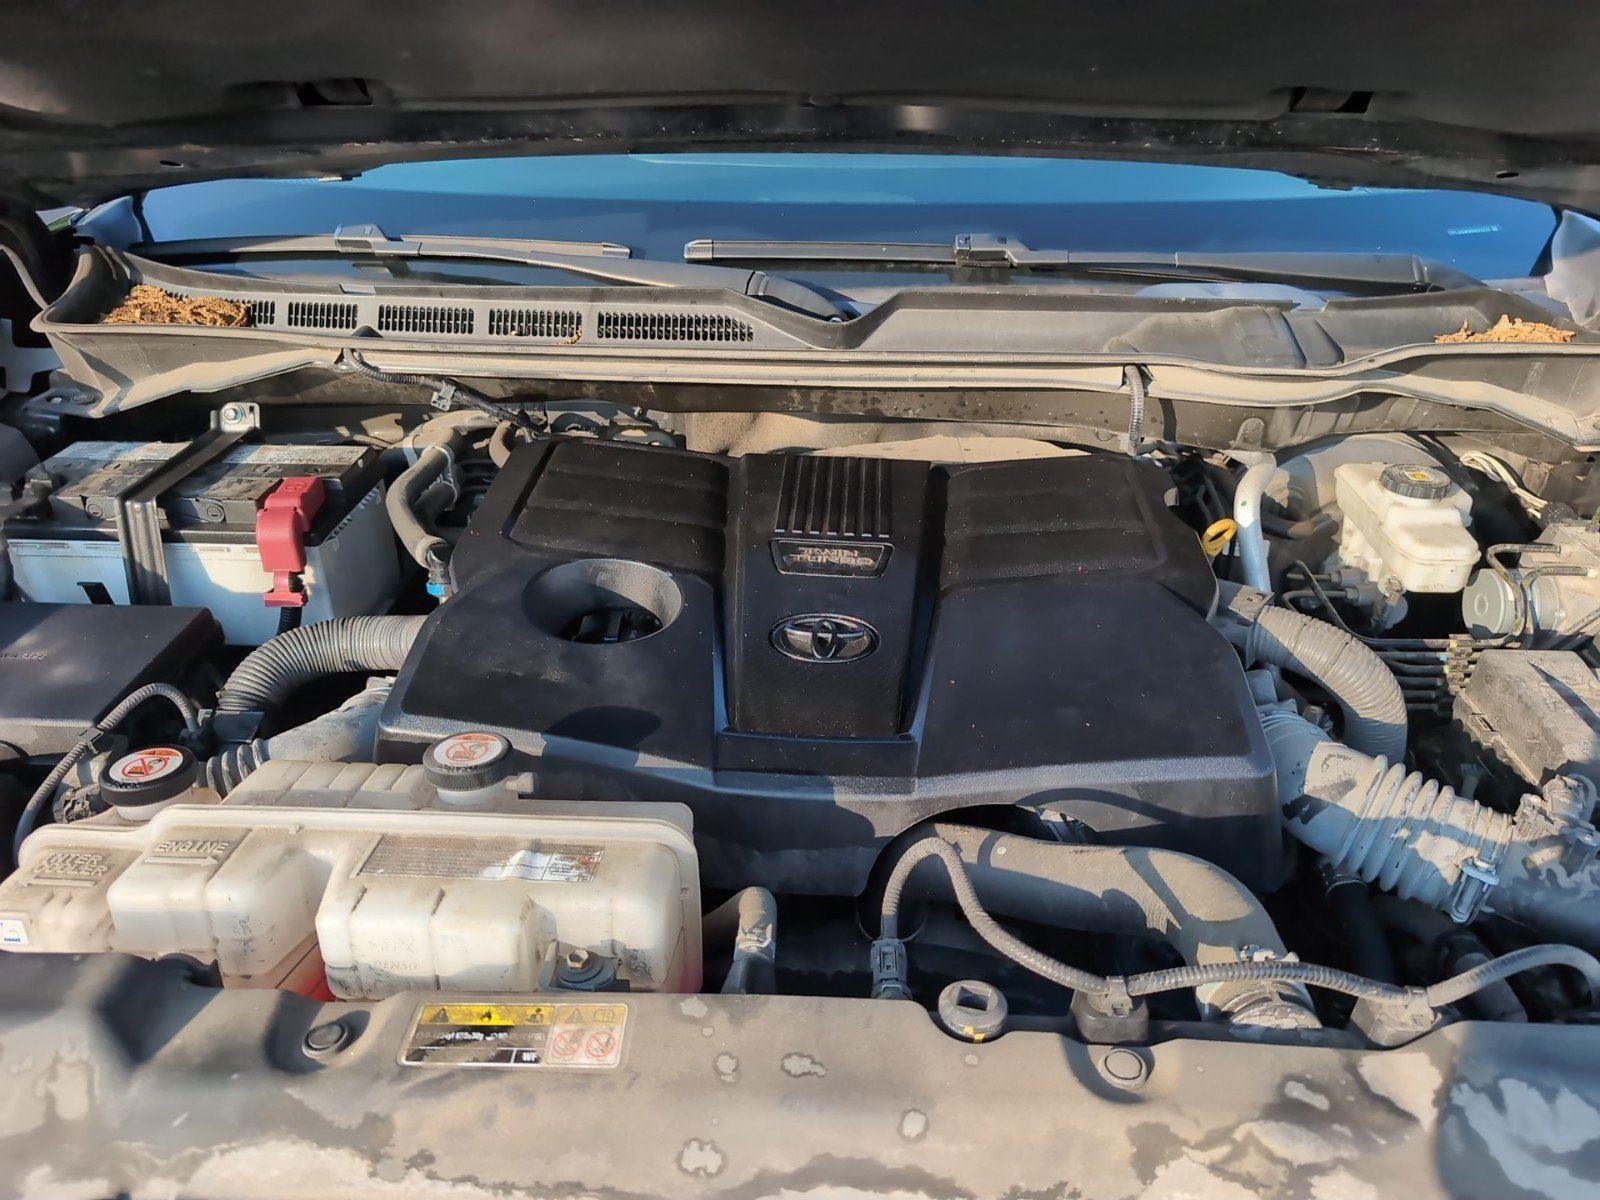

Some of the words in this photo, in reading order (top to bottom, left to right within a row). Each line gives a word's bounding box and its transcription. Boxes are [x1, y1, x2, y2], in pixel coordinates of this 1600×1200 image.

[154, 841, 229, 854] ENGINE
[43, 853, 104, 865] INTER
[34, 864, 108, 876] COOLER
